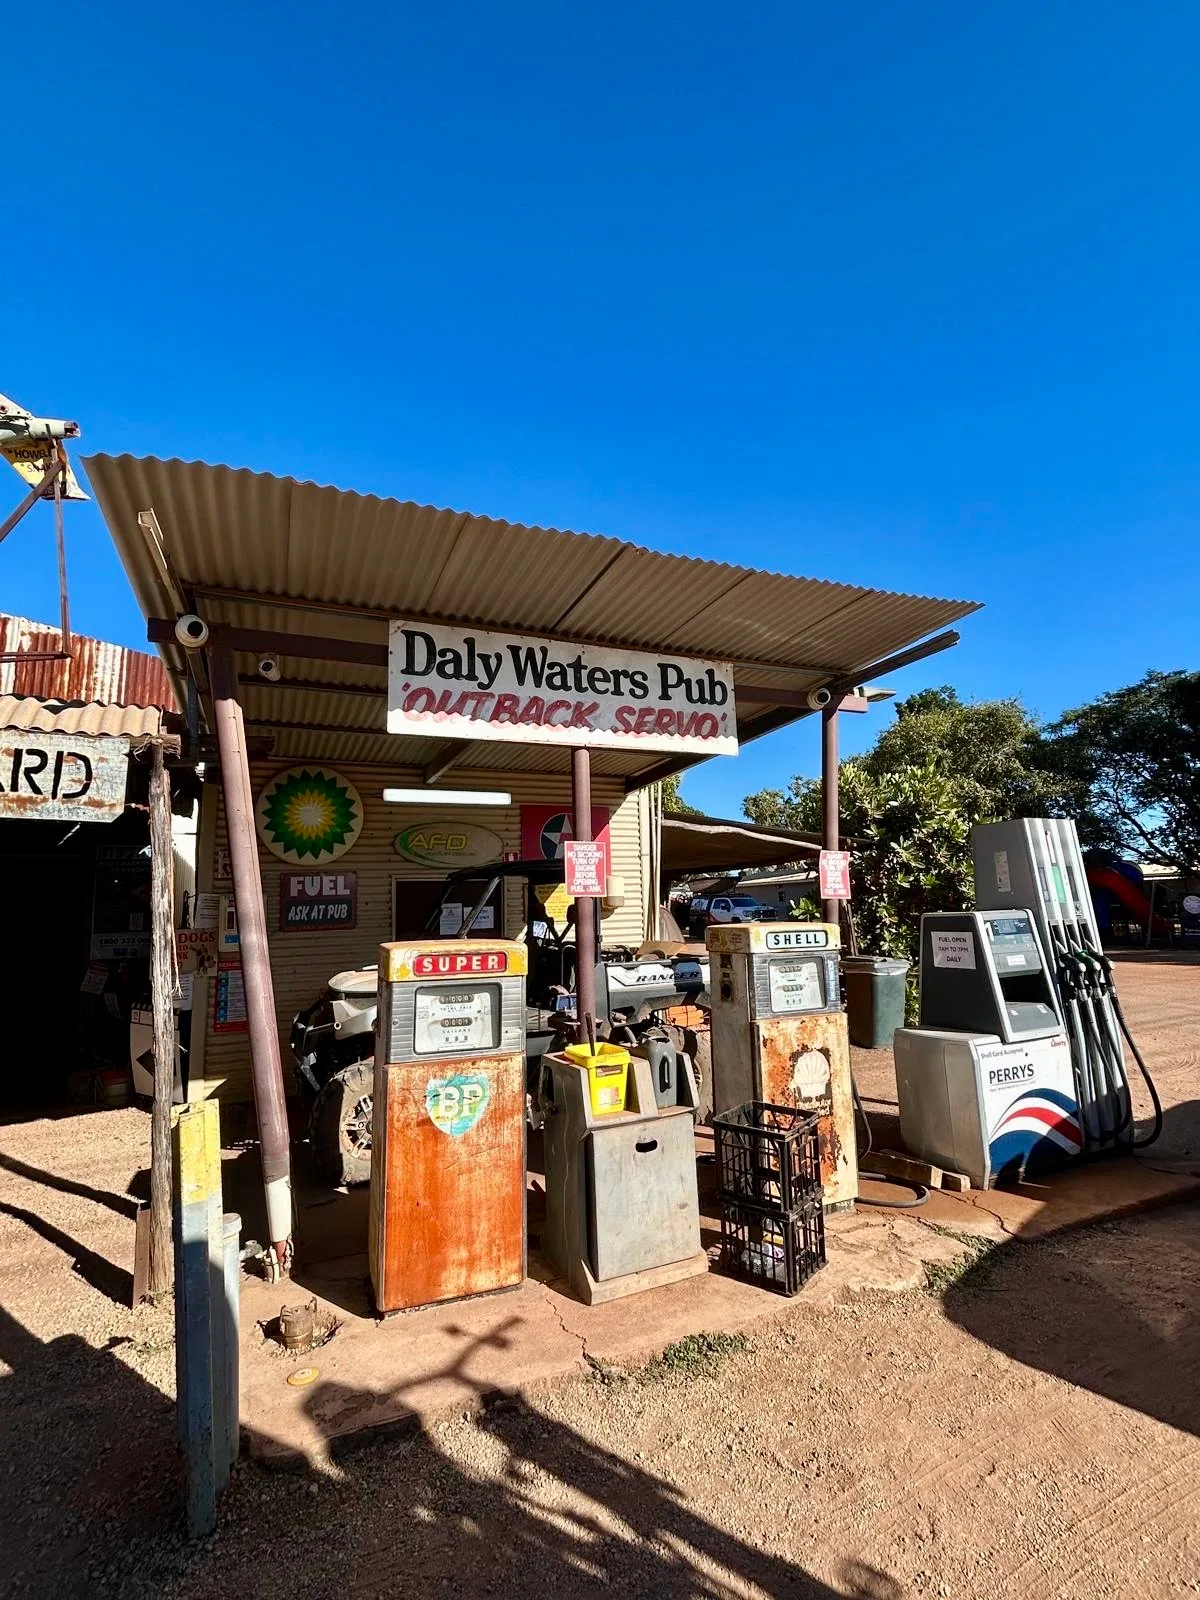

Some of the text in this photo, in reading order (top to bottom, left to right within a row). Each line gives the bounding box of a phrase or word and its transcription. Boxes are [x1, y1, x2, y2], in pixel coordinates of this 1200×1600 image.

[400, 629, 728, 706] Daly Waters Pub
[0, 748, 93, 800] RD
[574, 843, 597, 851] DANGER
[588, 857, 600, 865] OFF
[290, 876, 351, 897] FUEL
[570, 885, 585, 893] FUEL
[288, 903, 348, 921] ASK AT PUB
[178, 932, 216, 943] DOGS
[773, 934, 820, 946] SHELL
[422, 955, 499, 972] SUPER
[988, 1063, 1035, 1084] PERRYS
[438, 1084, 484, 1119] BP
